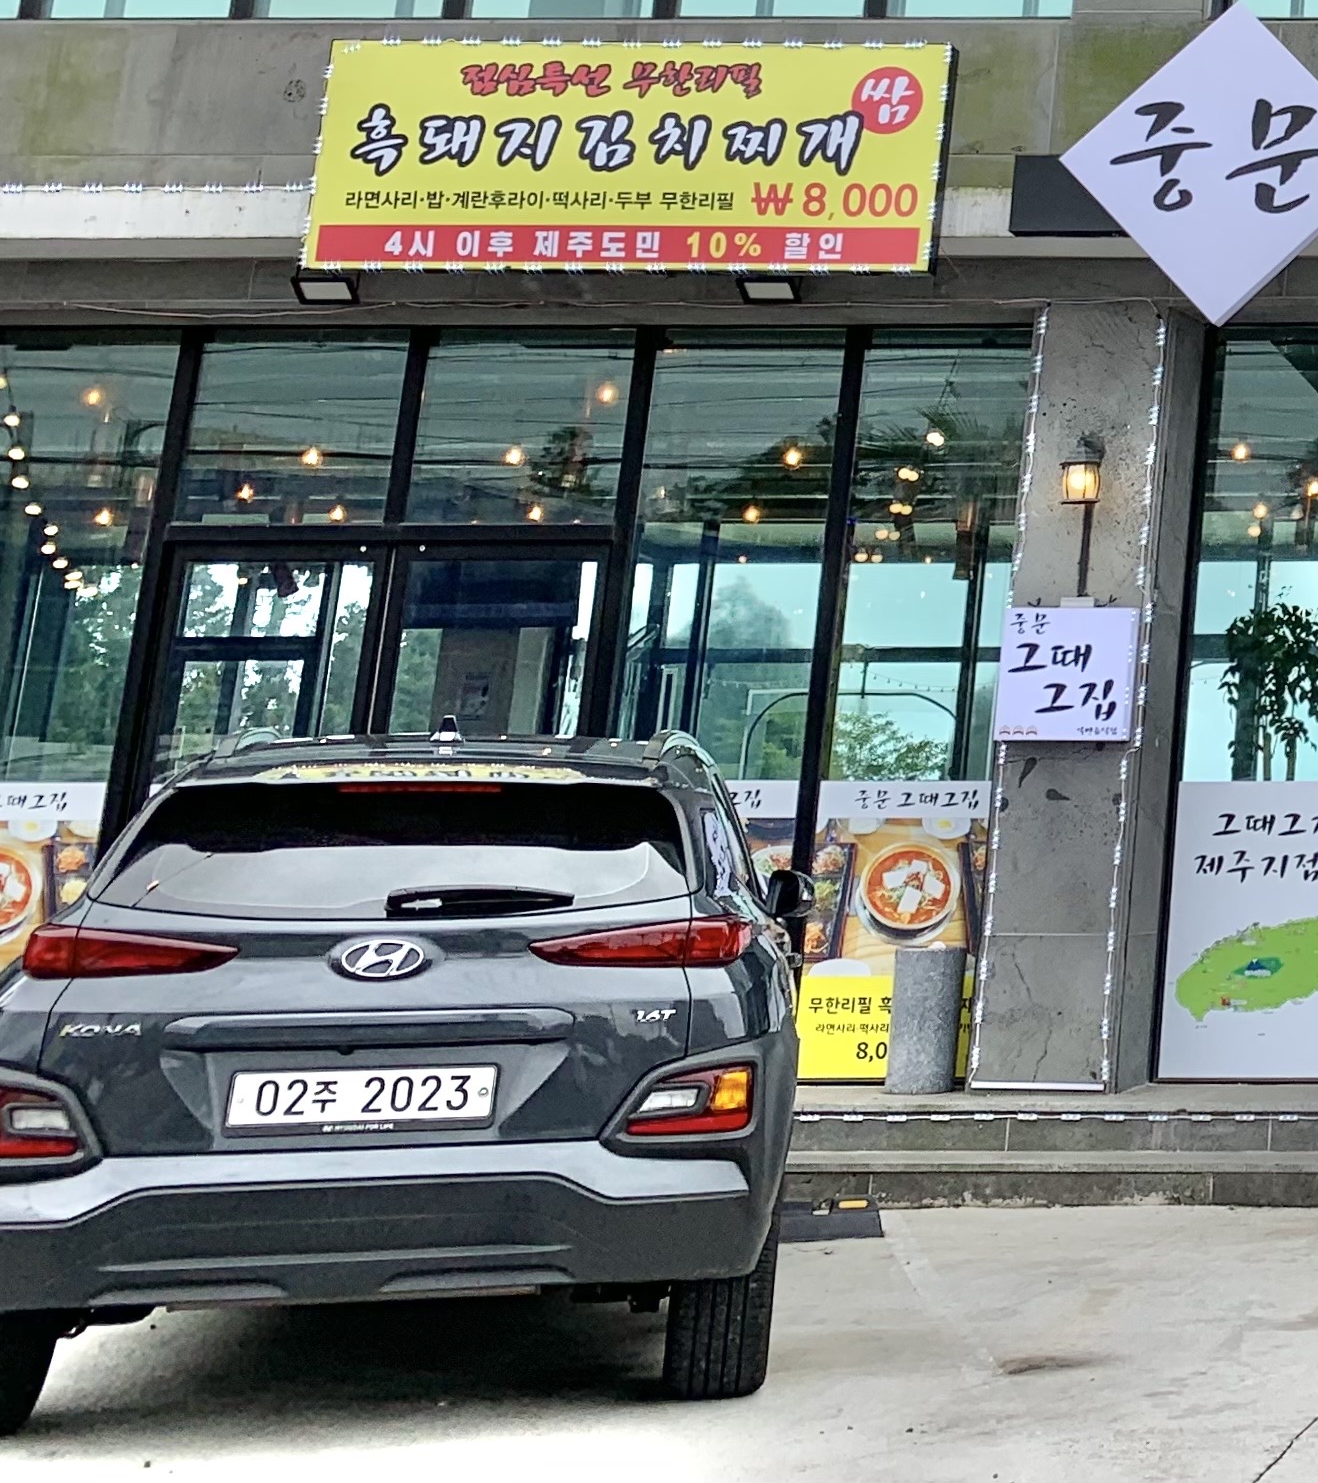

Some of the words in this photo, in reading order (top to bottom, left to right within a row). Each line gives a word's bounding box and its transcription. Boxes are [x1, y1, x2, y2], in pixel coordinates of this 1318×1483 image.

[461, 63, 611, 98] 점심특선
[624, 62, 763, 99] 무한리필
[352, 104, 865, 175] 흑돼지김치찌개
[659, 189, 735, 212] 무한리필
[384, 230, 435, 258] 4시
[457, 230, 514, 258] 이후
[533, 230, 660, 258] 제주도민
[687, 230, 762, 257] 10%
[784, 230, 844, 260] 할인
[1010, 613, 1051, 635] 중문
[1008, 642, 1092, 673] 그때
[1034, 679, 1117, 721] 그집
[0, 791, 67, 812] 때그집
[729, 789, 762, 810] 그집
[854, 789, 891, 810] 중문
[896, 789, 979, 810] 그때그집
[808, 997, 875, 1015] 무한리필
[815, 1023, 889, 1035] 라면사리·떡사리
[856, 1041, 888, 1063] 8,0
[255, 1079, 338, 1117] 02주
[361, 1075, 472, 1113] 2023
